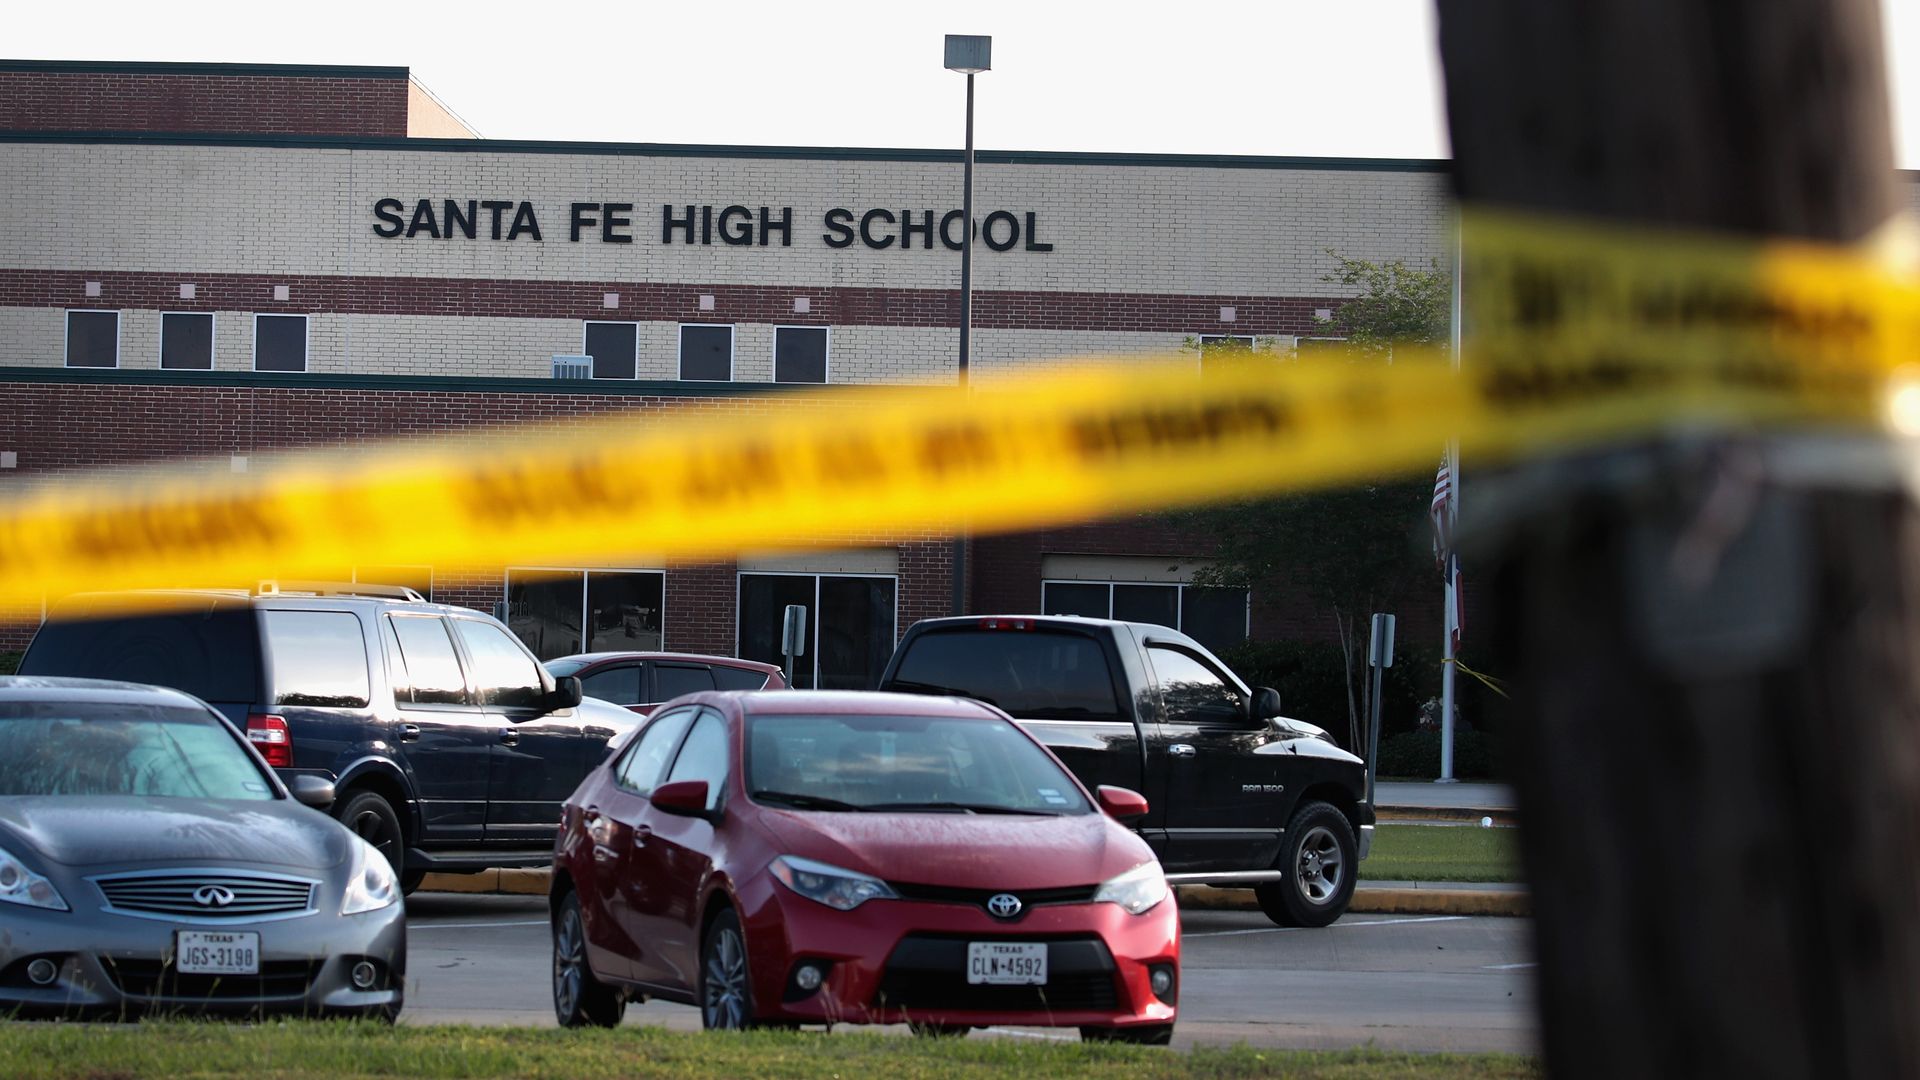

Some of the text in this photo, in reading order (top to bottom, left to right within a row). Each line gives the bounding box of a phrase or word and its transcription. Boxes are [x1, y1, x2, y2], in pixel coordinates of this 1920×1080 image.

[373, 198, 1053, 252] SANTA FE HIGH SCHOOL
[1242, 784, 1284, 792] RAM 1500
[204, 934, 233, 943] TEXAS
[993, 945, 1023, 954] TEXAS
